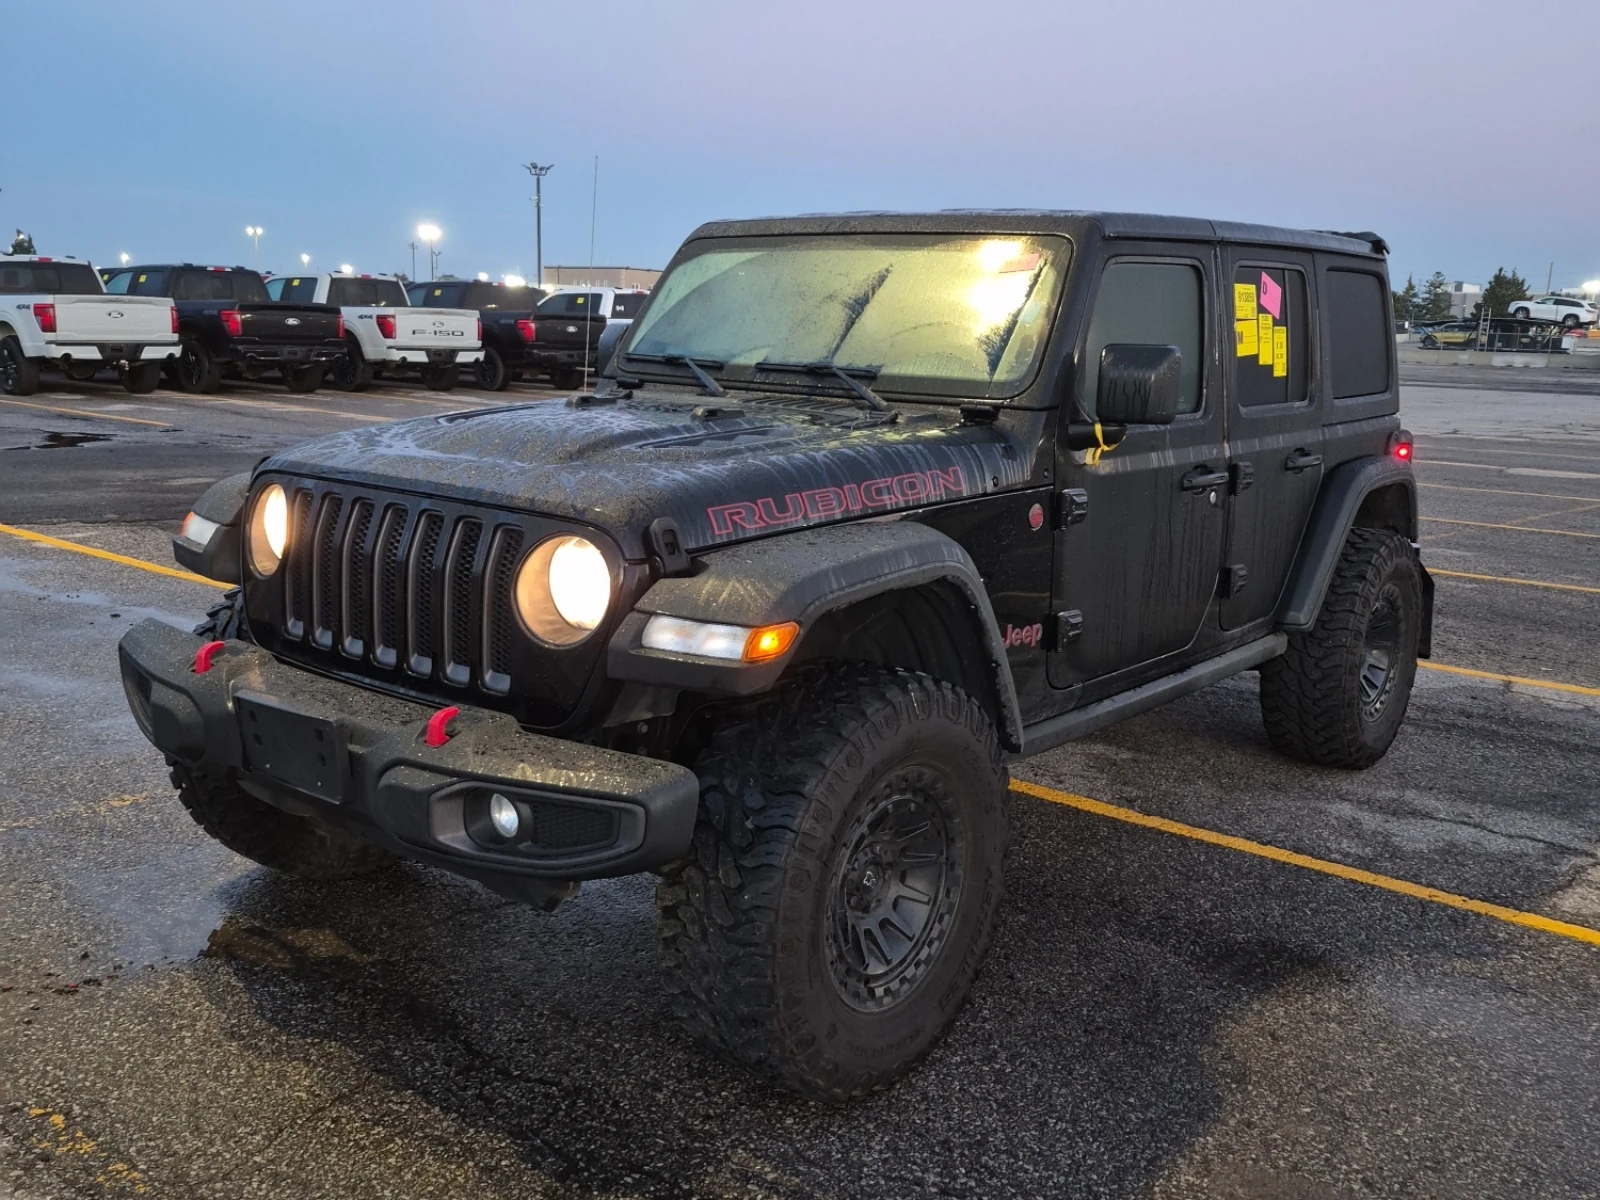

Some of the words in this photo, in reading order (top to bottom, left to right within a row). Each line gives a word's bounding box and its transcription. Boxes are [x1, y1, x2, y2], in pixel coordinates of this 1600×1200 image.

[412, 329, 464, 337] F-150
[706, 466, 965, 536] RUBICON
[1002, 622, 1043, 649] Jeep
